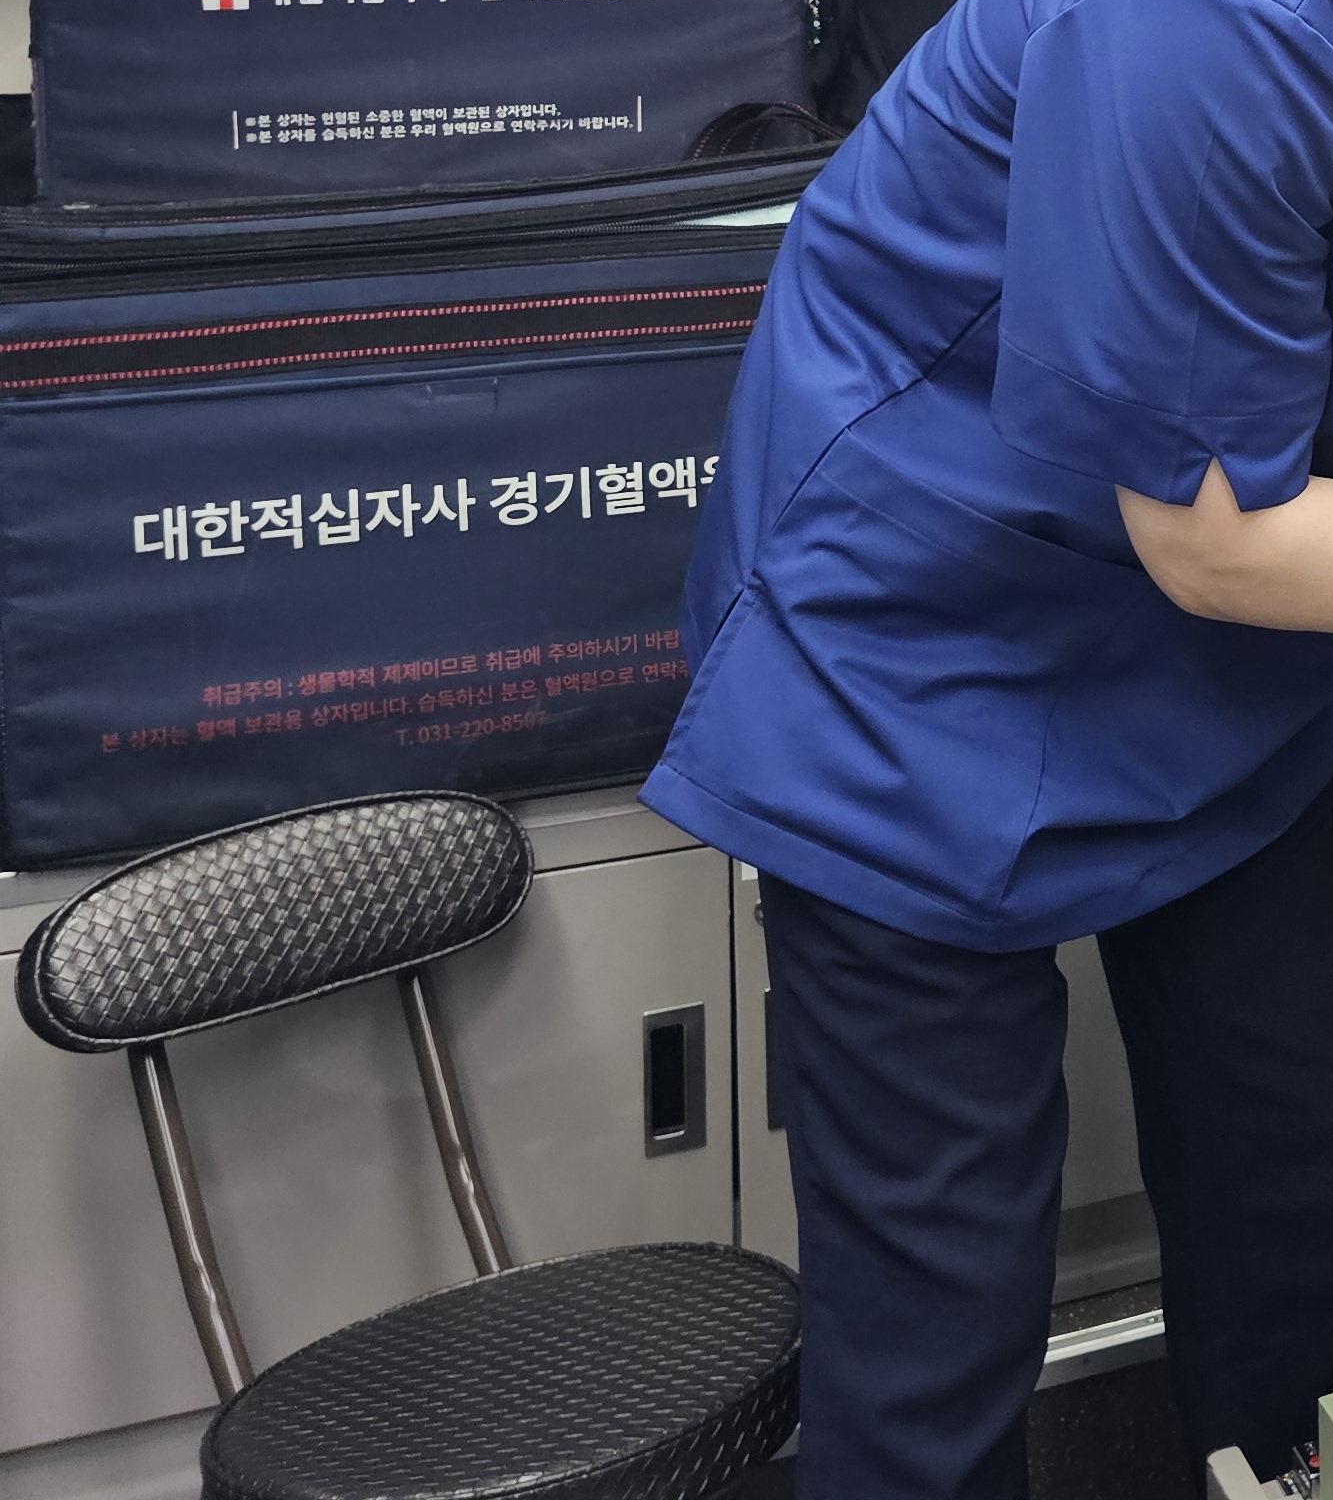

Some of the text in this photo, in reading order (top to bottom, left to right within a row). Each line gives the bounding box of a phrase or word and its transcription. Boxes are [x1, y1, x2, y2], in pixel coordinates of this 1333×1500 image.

[277, 113, 316, 127] 상자는
[366, 109, 404, 123] 소중한
[410, 107, 447, 122] 혈액이
[453, 105, 490, 119] 보관된
[277, 128, 316, 142] 상자를
[322, 125, 375, 141] 습득하신
[380, 124, 406, 138] 분은
[410, 123, 436, 137] 우리
[442, 120, 506, 136] 혈액원으로
[511, 118, 574, 133] 연락주시기
[133, 453, 722, 561] 대한적십자사 경기혈액
[203, 677, 283, 707] 취급주의
[299, 666, 375, 696] 생물학적
[382, 654, 478, 684] 제제이므로
[485, 645, 541, 672] 취급에
[548, 633, 638, 664] 주의하시기
[419, 685, 493, 712] 습득하신
[500, 679, 538, 702] 분은
[545, 668, 635, 697] 혈액원으로
